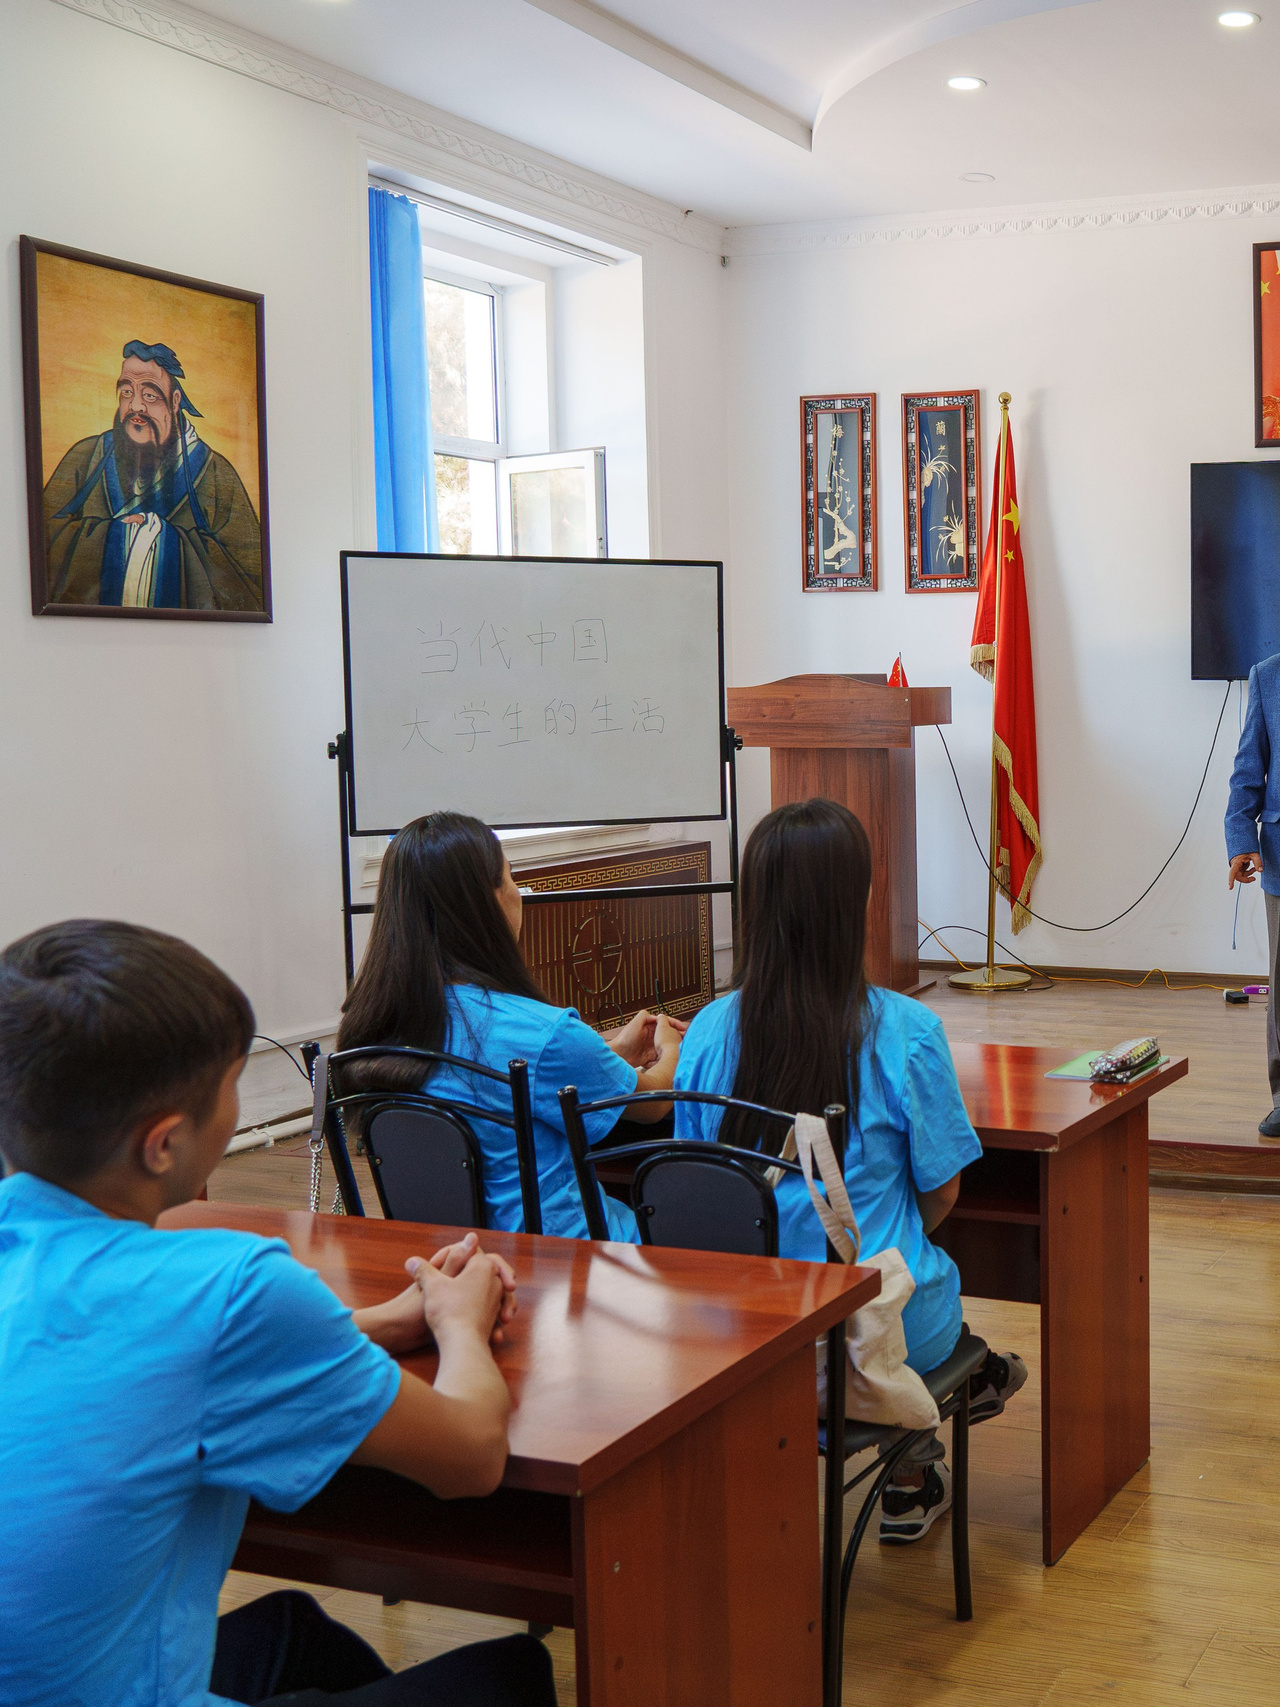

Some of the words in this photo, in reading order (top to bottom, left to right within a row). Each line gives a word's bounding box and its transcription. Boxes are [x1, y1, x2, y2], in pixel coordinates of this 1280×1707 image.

[416, 618, 609, 675] 当代中国
[401, 695, 666, 754] 大学生的生活
